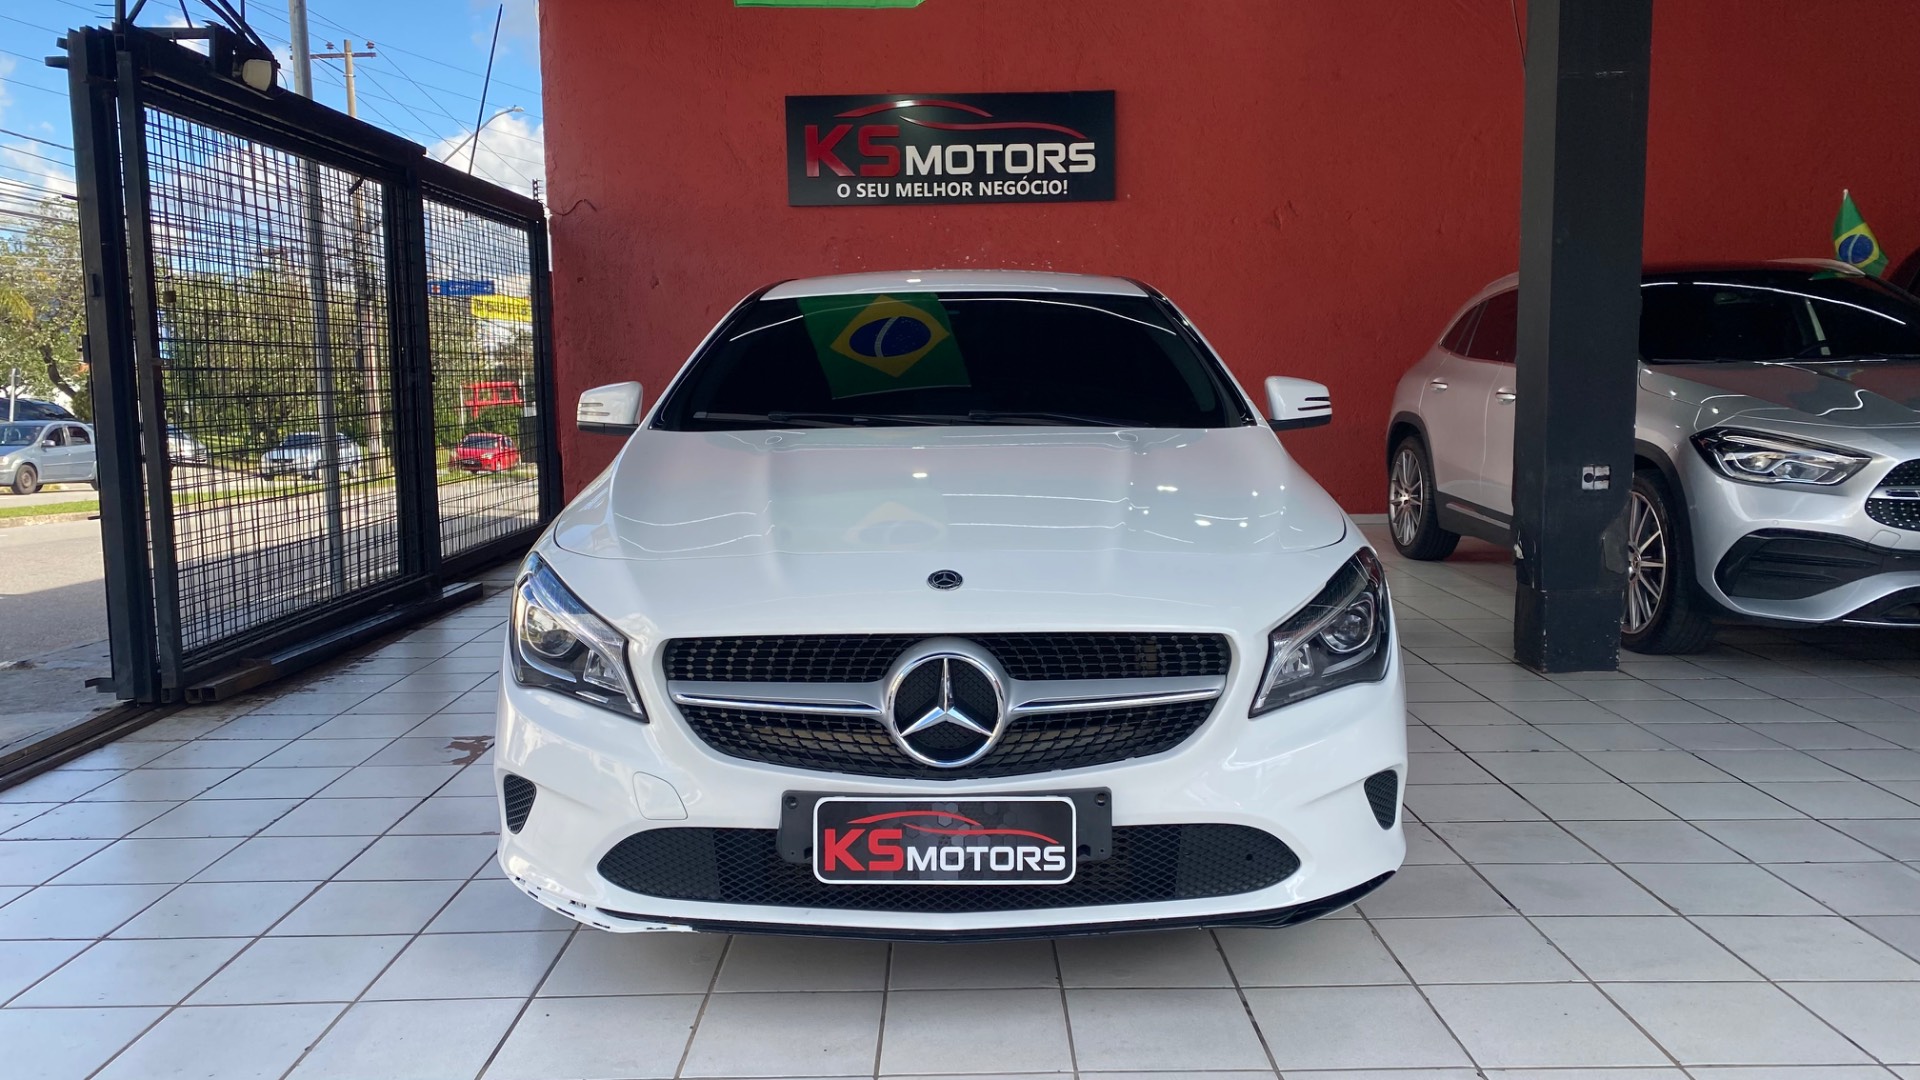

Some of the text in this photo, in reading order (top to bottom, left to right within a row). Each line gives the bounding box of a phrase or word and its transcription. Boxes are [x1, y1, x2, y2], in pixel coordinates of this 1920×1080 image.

[804, 124, 1096, 178] KS MOTORS
[837, 175, 1068, 198] O SEU MELHOR NEGÓCIO!
[824, 828, 1066, 872] KS MOTORS
